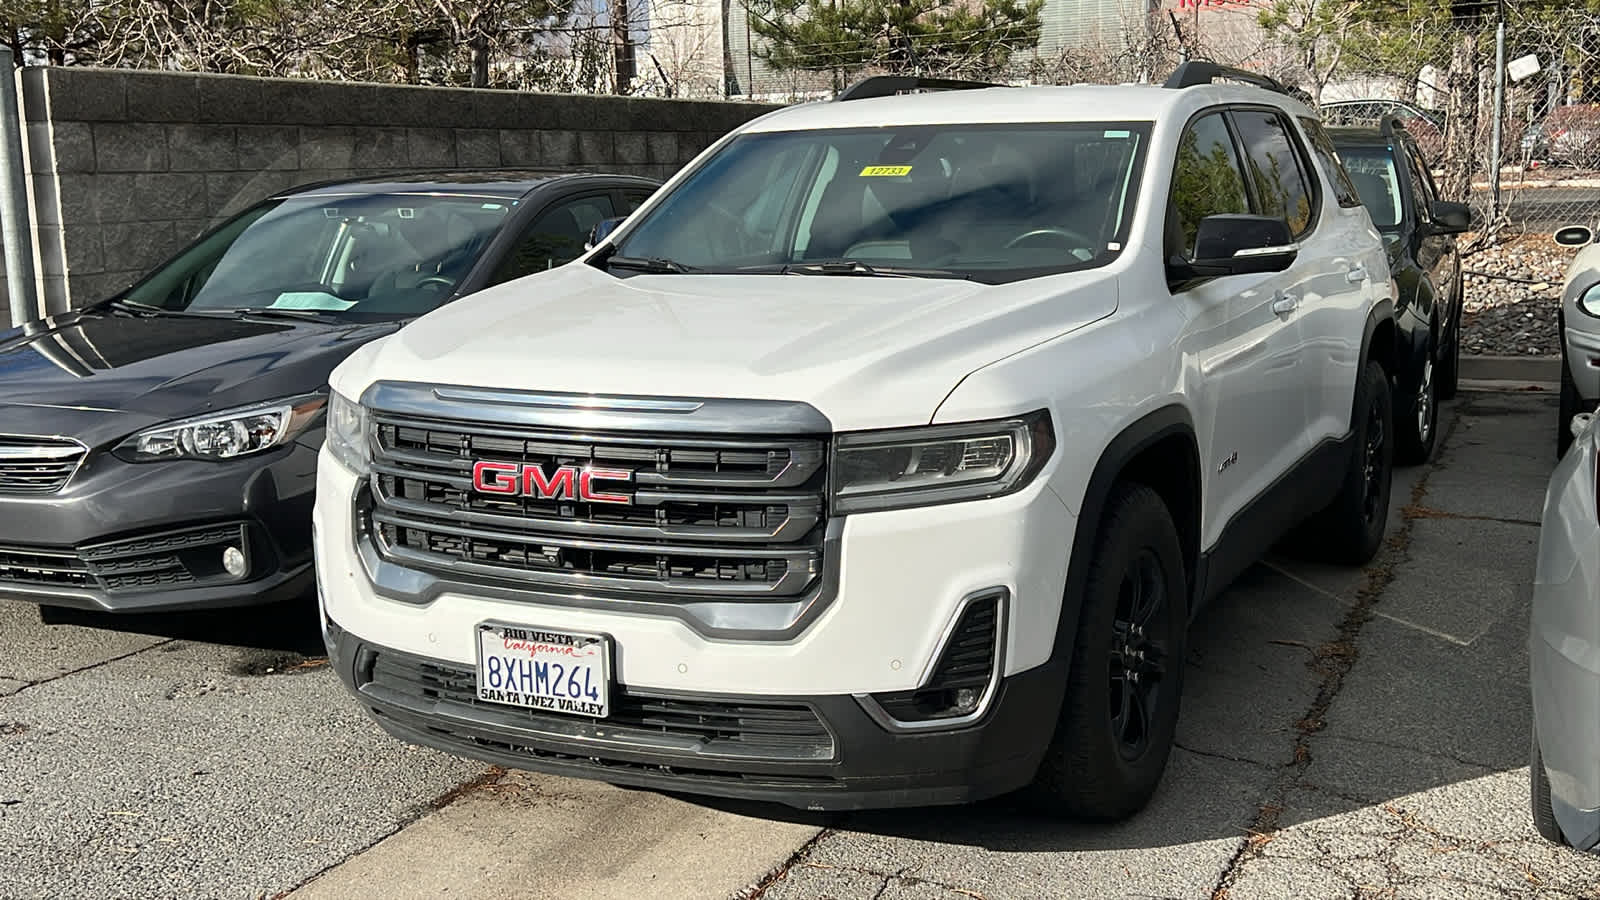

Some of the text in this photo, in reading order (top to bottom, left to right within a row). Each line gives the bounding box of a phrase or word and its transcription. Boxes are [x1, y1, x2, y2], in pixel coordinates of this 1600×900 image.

[473, 460, 635, 505] GMC
[503, 637, 584, 657] California
[531, 630, 575, 646] VISTA
[488, 655, 599, 702] 8XHM264
[480, 687, 604, 716] SANTA YNEZ VALLEY
